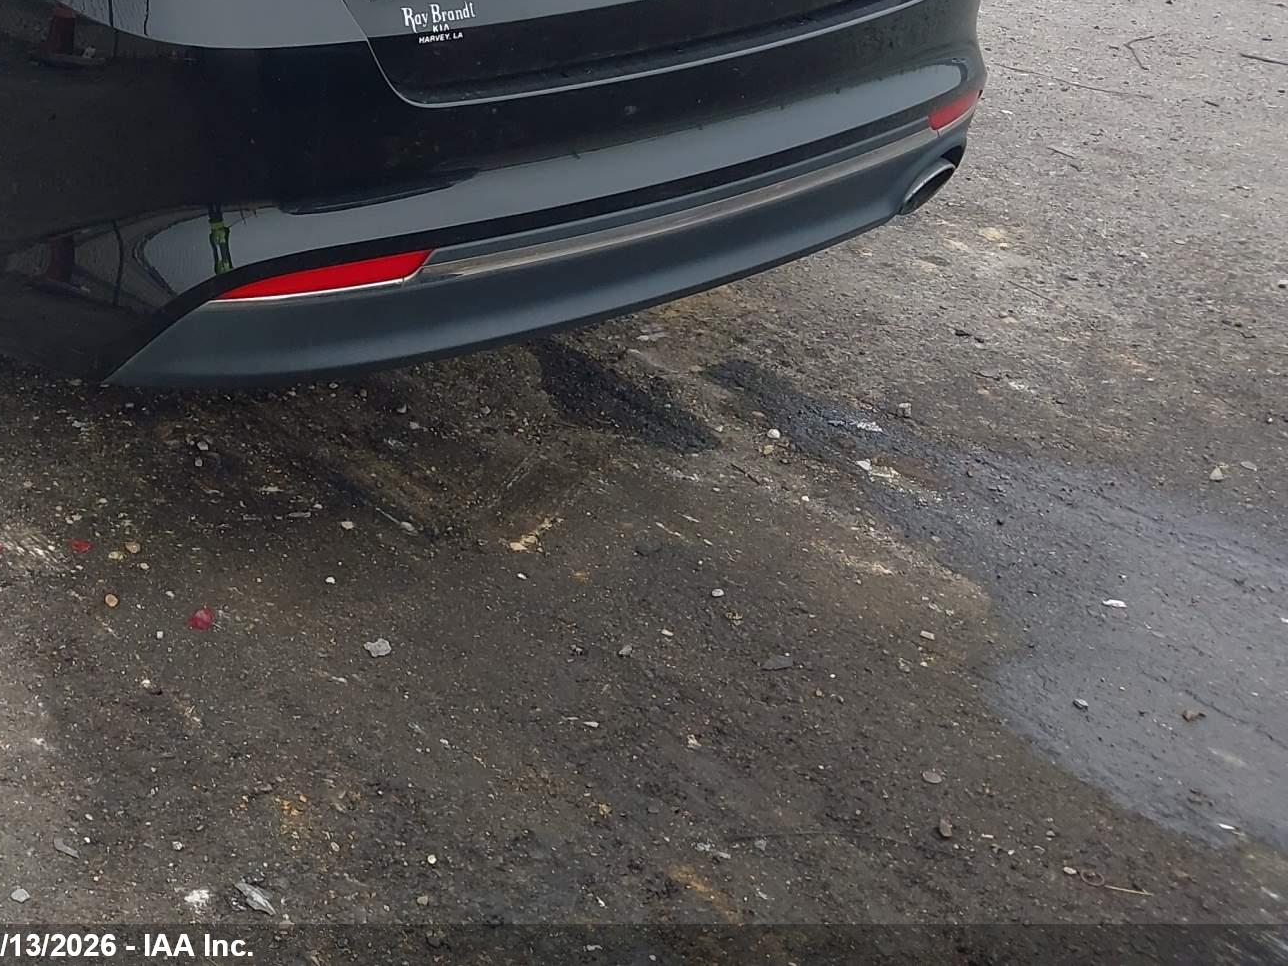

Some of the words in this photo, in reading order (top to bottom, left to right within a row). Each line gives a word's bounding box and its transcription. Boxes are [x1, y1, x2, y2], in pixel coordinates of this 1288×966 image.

[401, 7, 428, 33] Ray
[430, 1, 476, 23] Brandt
[432, 24, 450, 33] KIA
